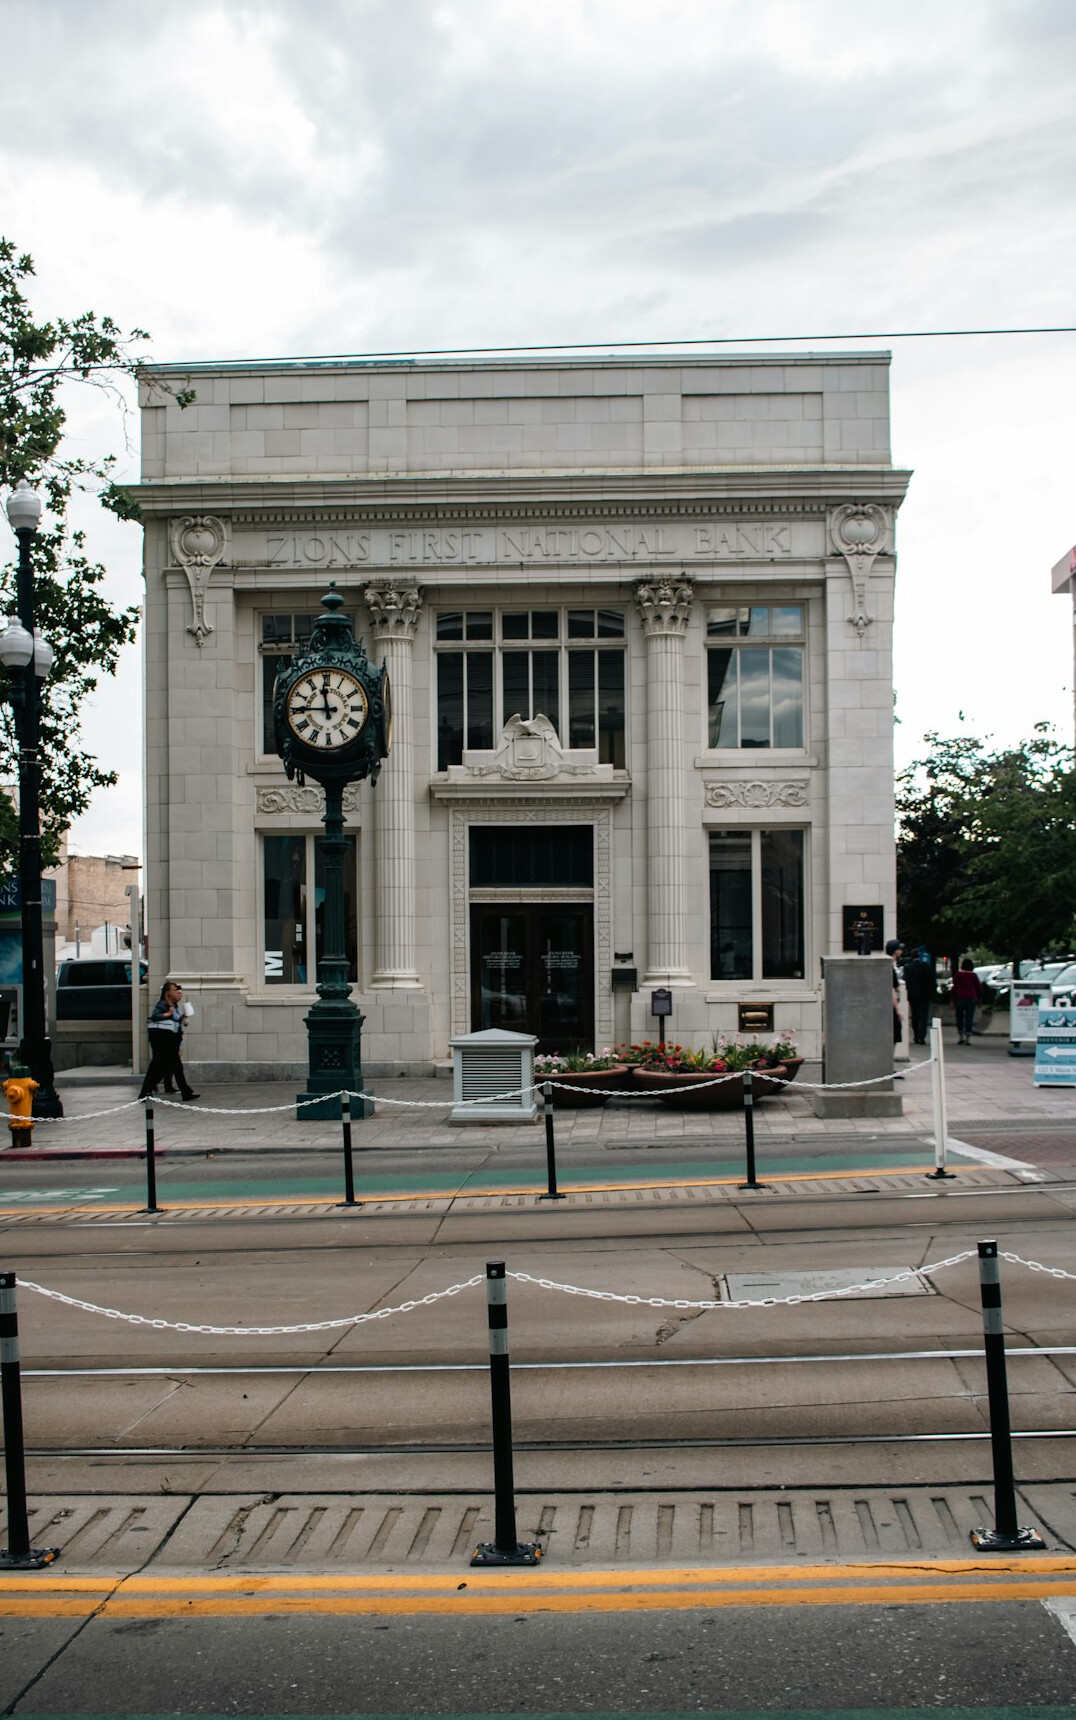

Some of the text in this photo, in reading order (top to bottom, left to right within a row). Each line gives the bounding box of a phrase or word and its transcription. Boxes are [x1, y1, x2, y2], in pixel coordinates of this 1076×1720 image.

[267, 527, 792, 563] ZIONS FIRST NATIONAL BANK
[306, 692, 317, 710] IRST
